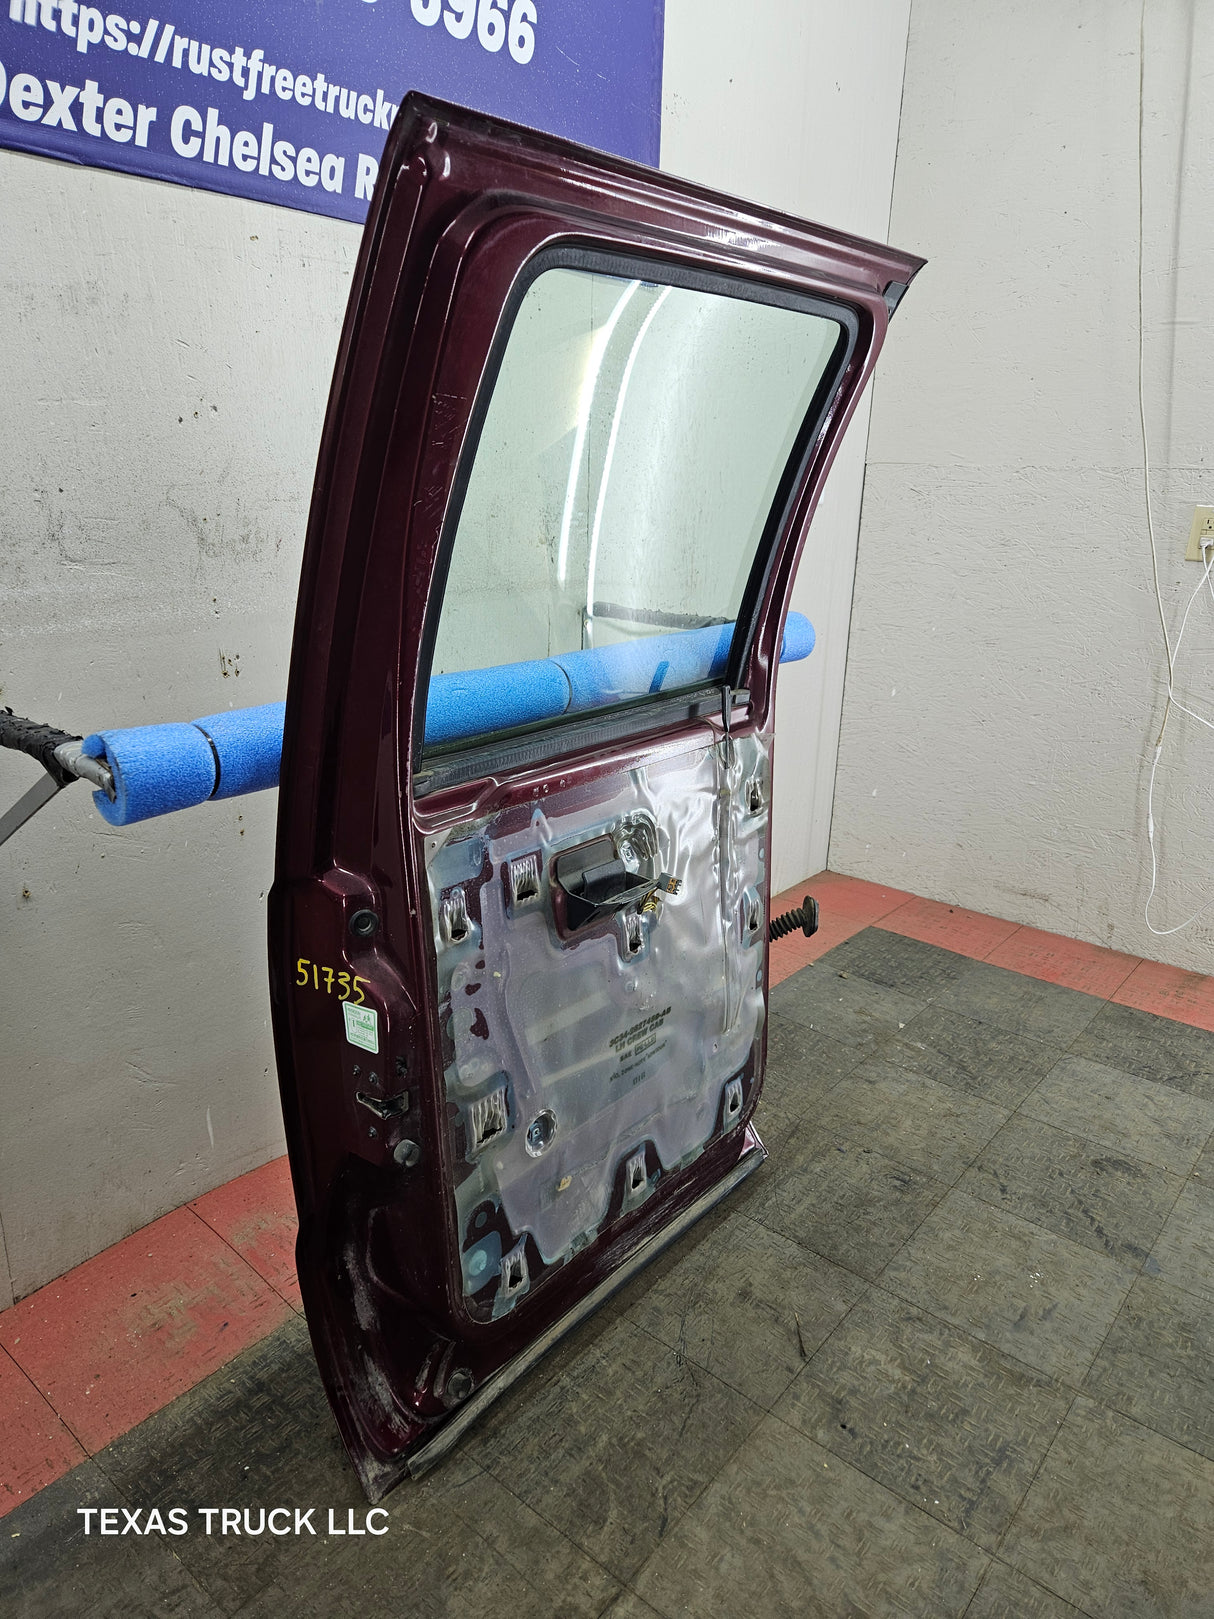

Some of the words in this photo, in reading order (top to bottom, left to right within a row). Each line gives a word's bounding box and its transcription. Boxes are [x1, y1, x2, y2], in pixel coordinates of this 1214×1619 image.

[0, 60, 157, 148] exter
[170, 105, 345, 194] Chelsea
[296, 958, 371, 1005] 51735
[627, 1028, 648, 1046] CREW
[649, 1018, 665, 1033] CAB
